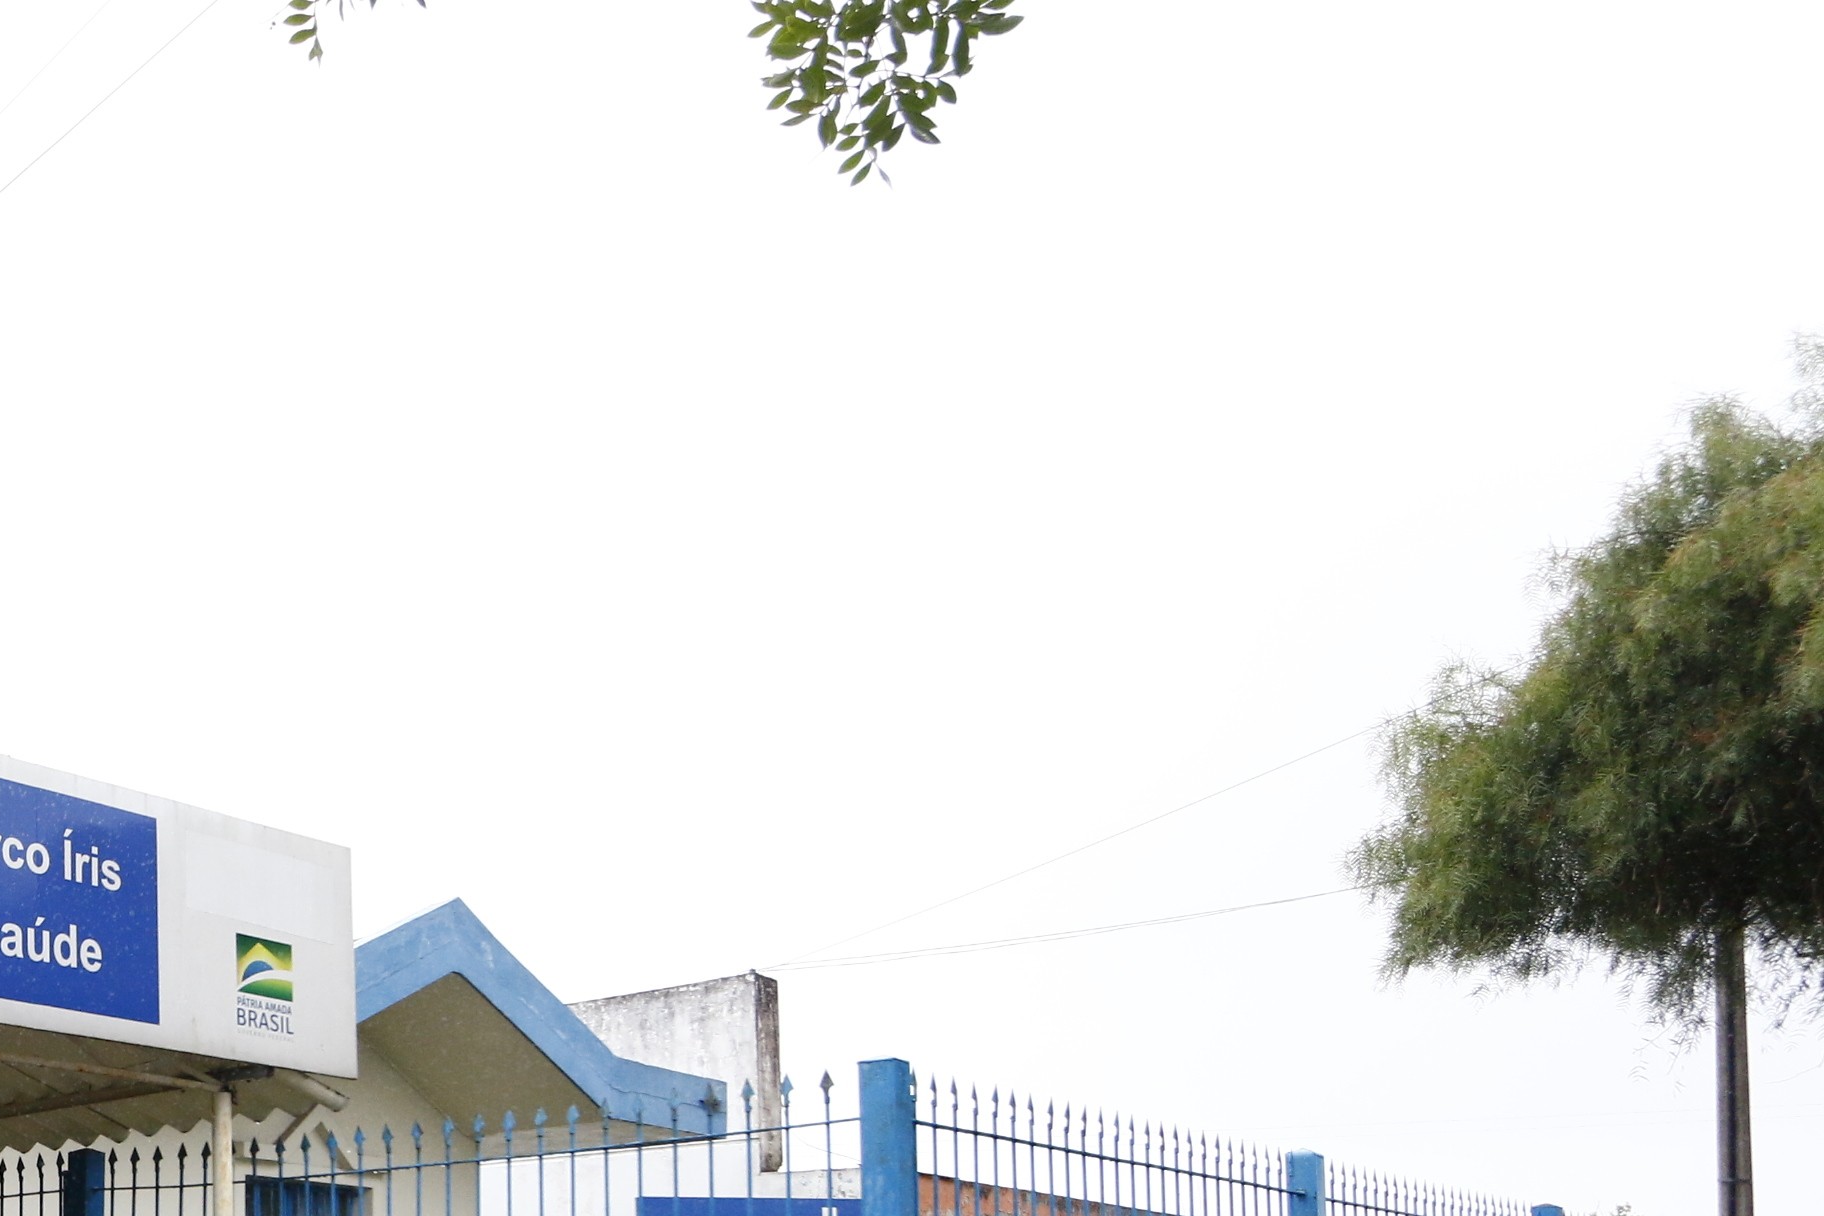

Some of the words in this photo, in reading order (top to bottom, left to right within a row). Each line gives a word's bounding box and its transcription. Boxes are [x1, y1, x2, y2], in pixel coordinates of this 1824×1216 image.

[62, 829, 122, 892] Íris
[237, 1007, 294, 1035] BRASIL
[265, 1002, 292, 1015] AMADA
